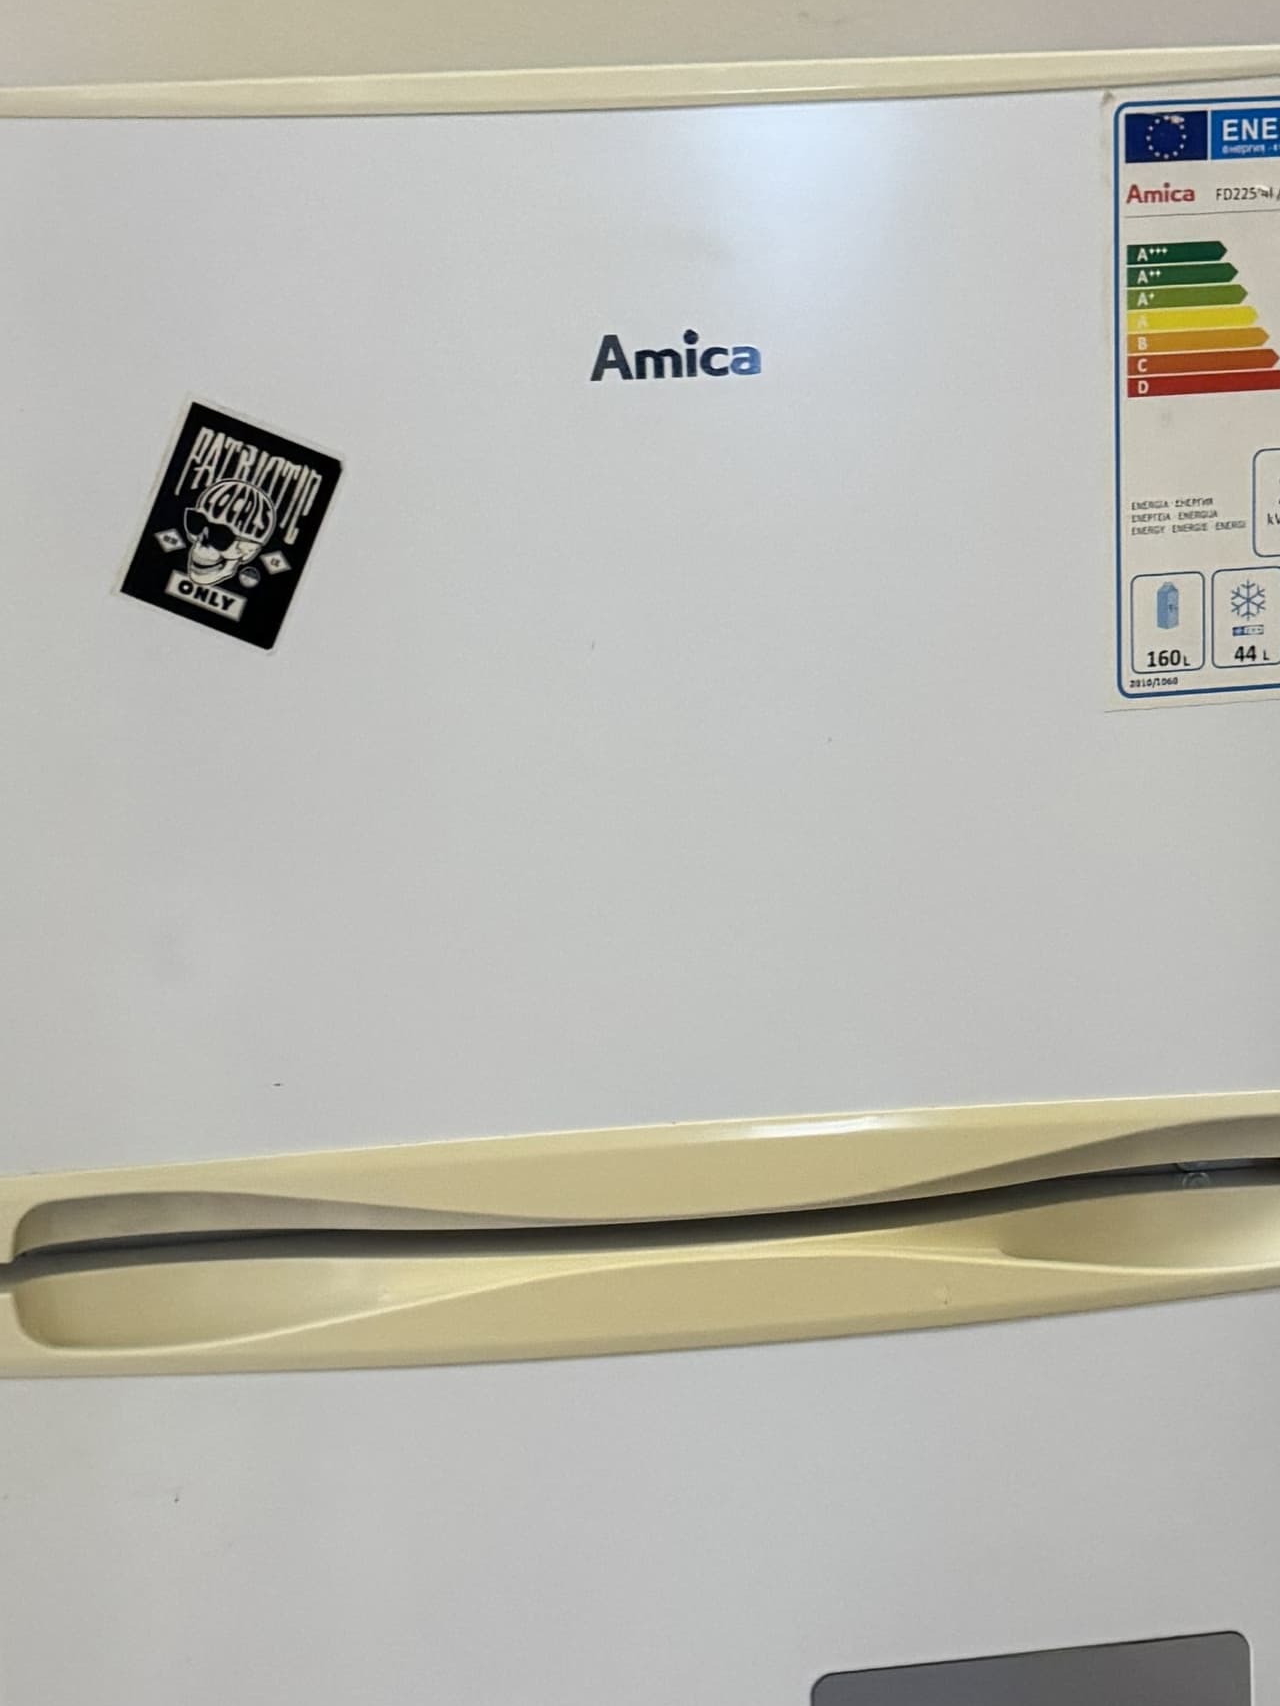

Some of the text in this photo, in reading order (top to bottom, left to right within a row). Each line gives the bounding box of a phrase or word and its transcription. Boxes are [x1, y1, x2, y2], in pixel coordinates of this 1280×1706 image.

[1125, 182, 1196, 204] Amica
[1136, 246, 1168, 262] A+++
[1136, 269, 1162, 284] A++
[1136, 291, 1156, 307] A+
[1137, 336, 1148, 351] B
[589, 328, 762, 382] Amica
[1137, 358, 1148, 373] C
[1137, 380, 1149, 395] D
[177, 579, 236, 611] ONLY
[1146, 649, 1191, 668] 160 L
[1233, 645, 1270, 662] 44 L
